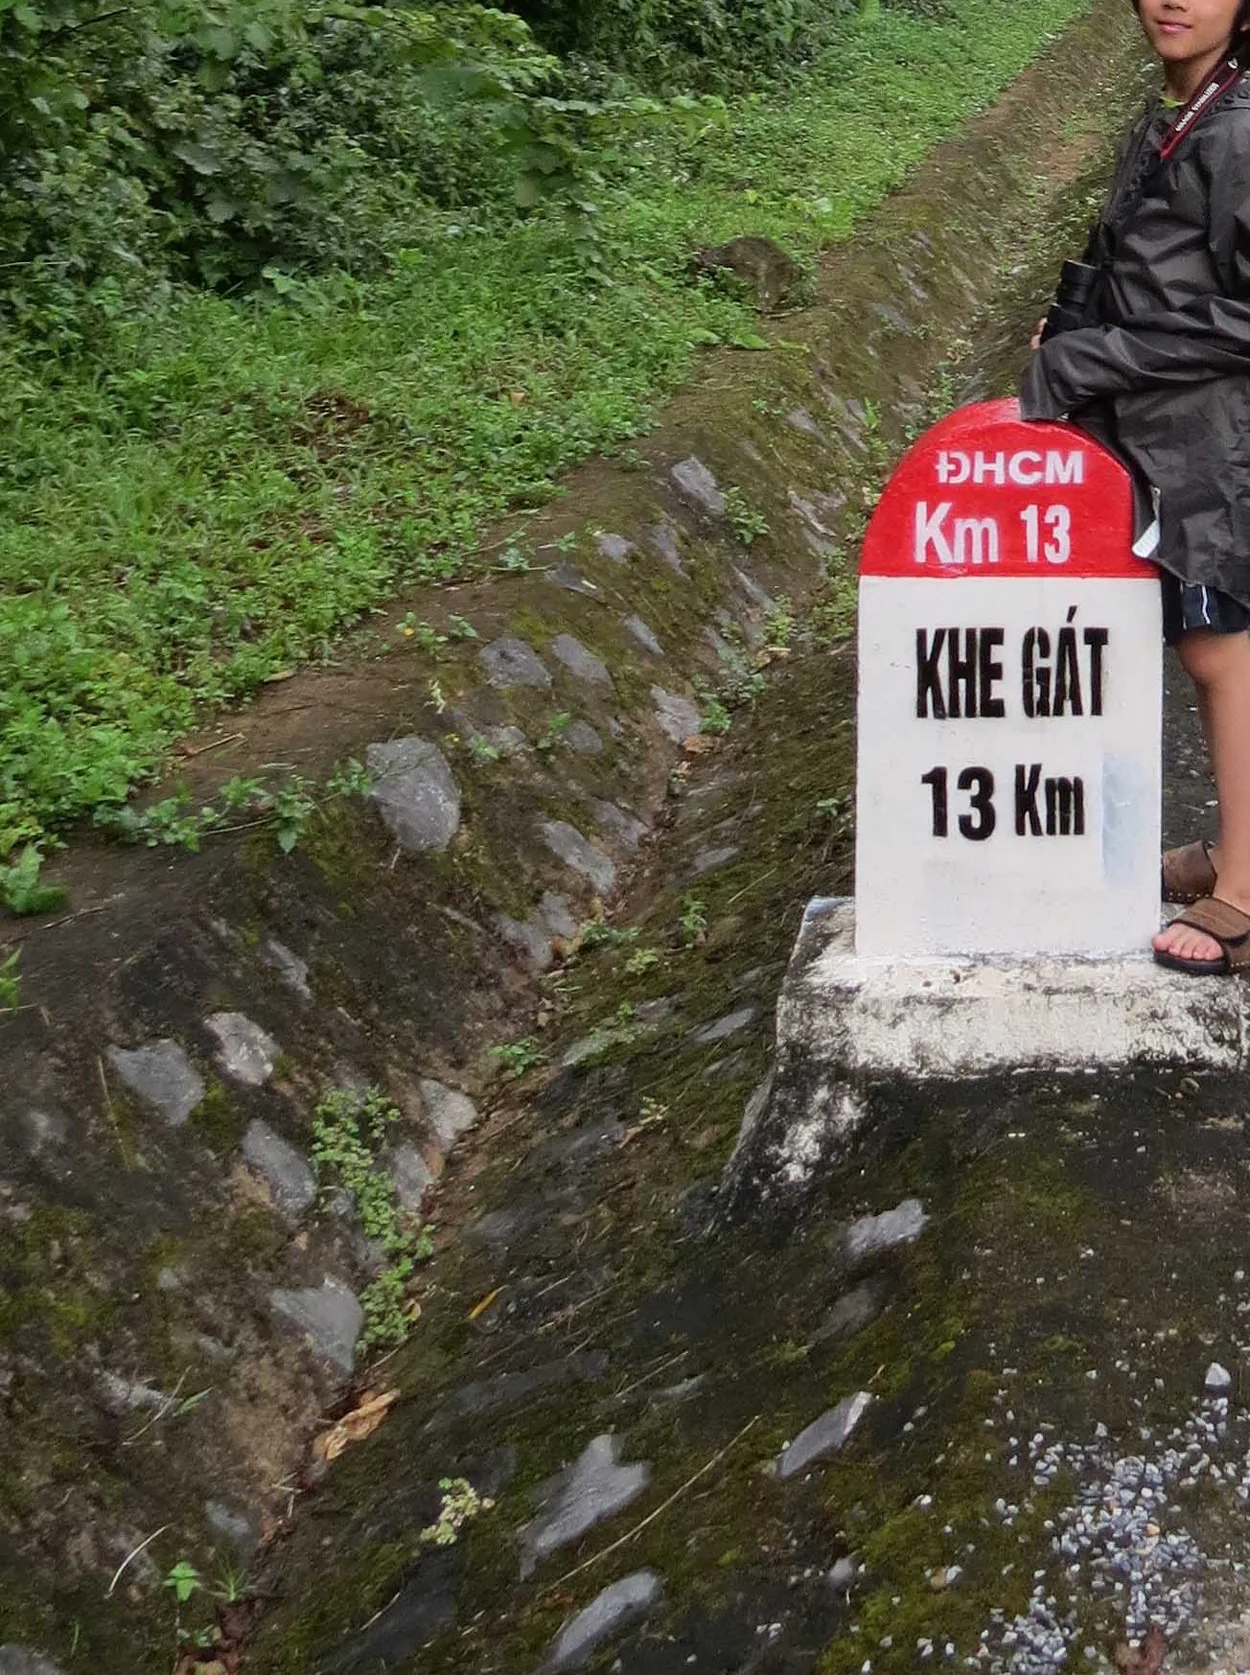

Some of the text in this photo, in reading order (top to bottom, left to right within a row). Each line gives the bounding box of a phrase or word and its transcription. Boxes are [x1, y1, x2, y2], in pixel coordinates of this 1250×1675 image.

[935, 450, 1084, 485] ĐHCM
[914, 501, 999, 565] Km
[1020, 504, 1070, 564] 13
[916, 605, 1109, 719] KHE GÁT
[921, 763, 1085, 842] 13 Km
